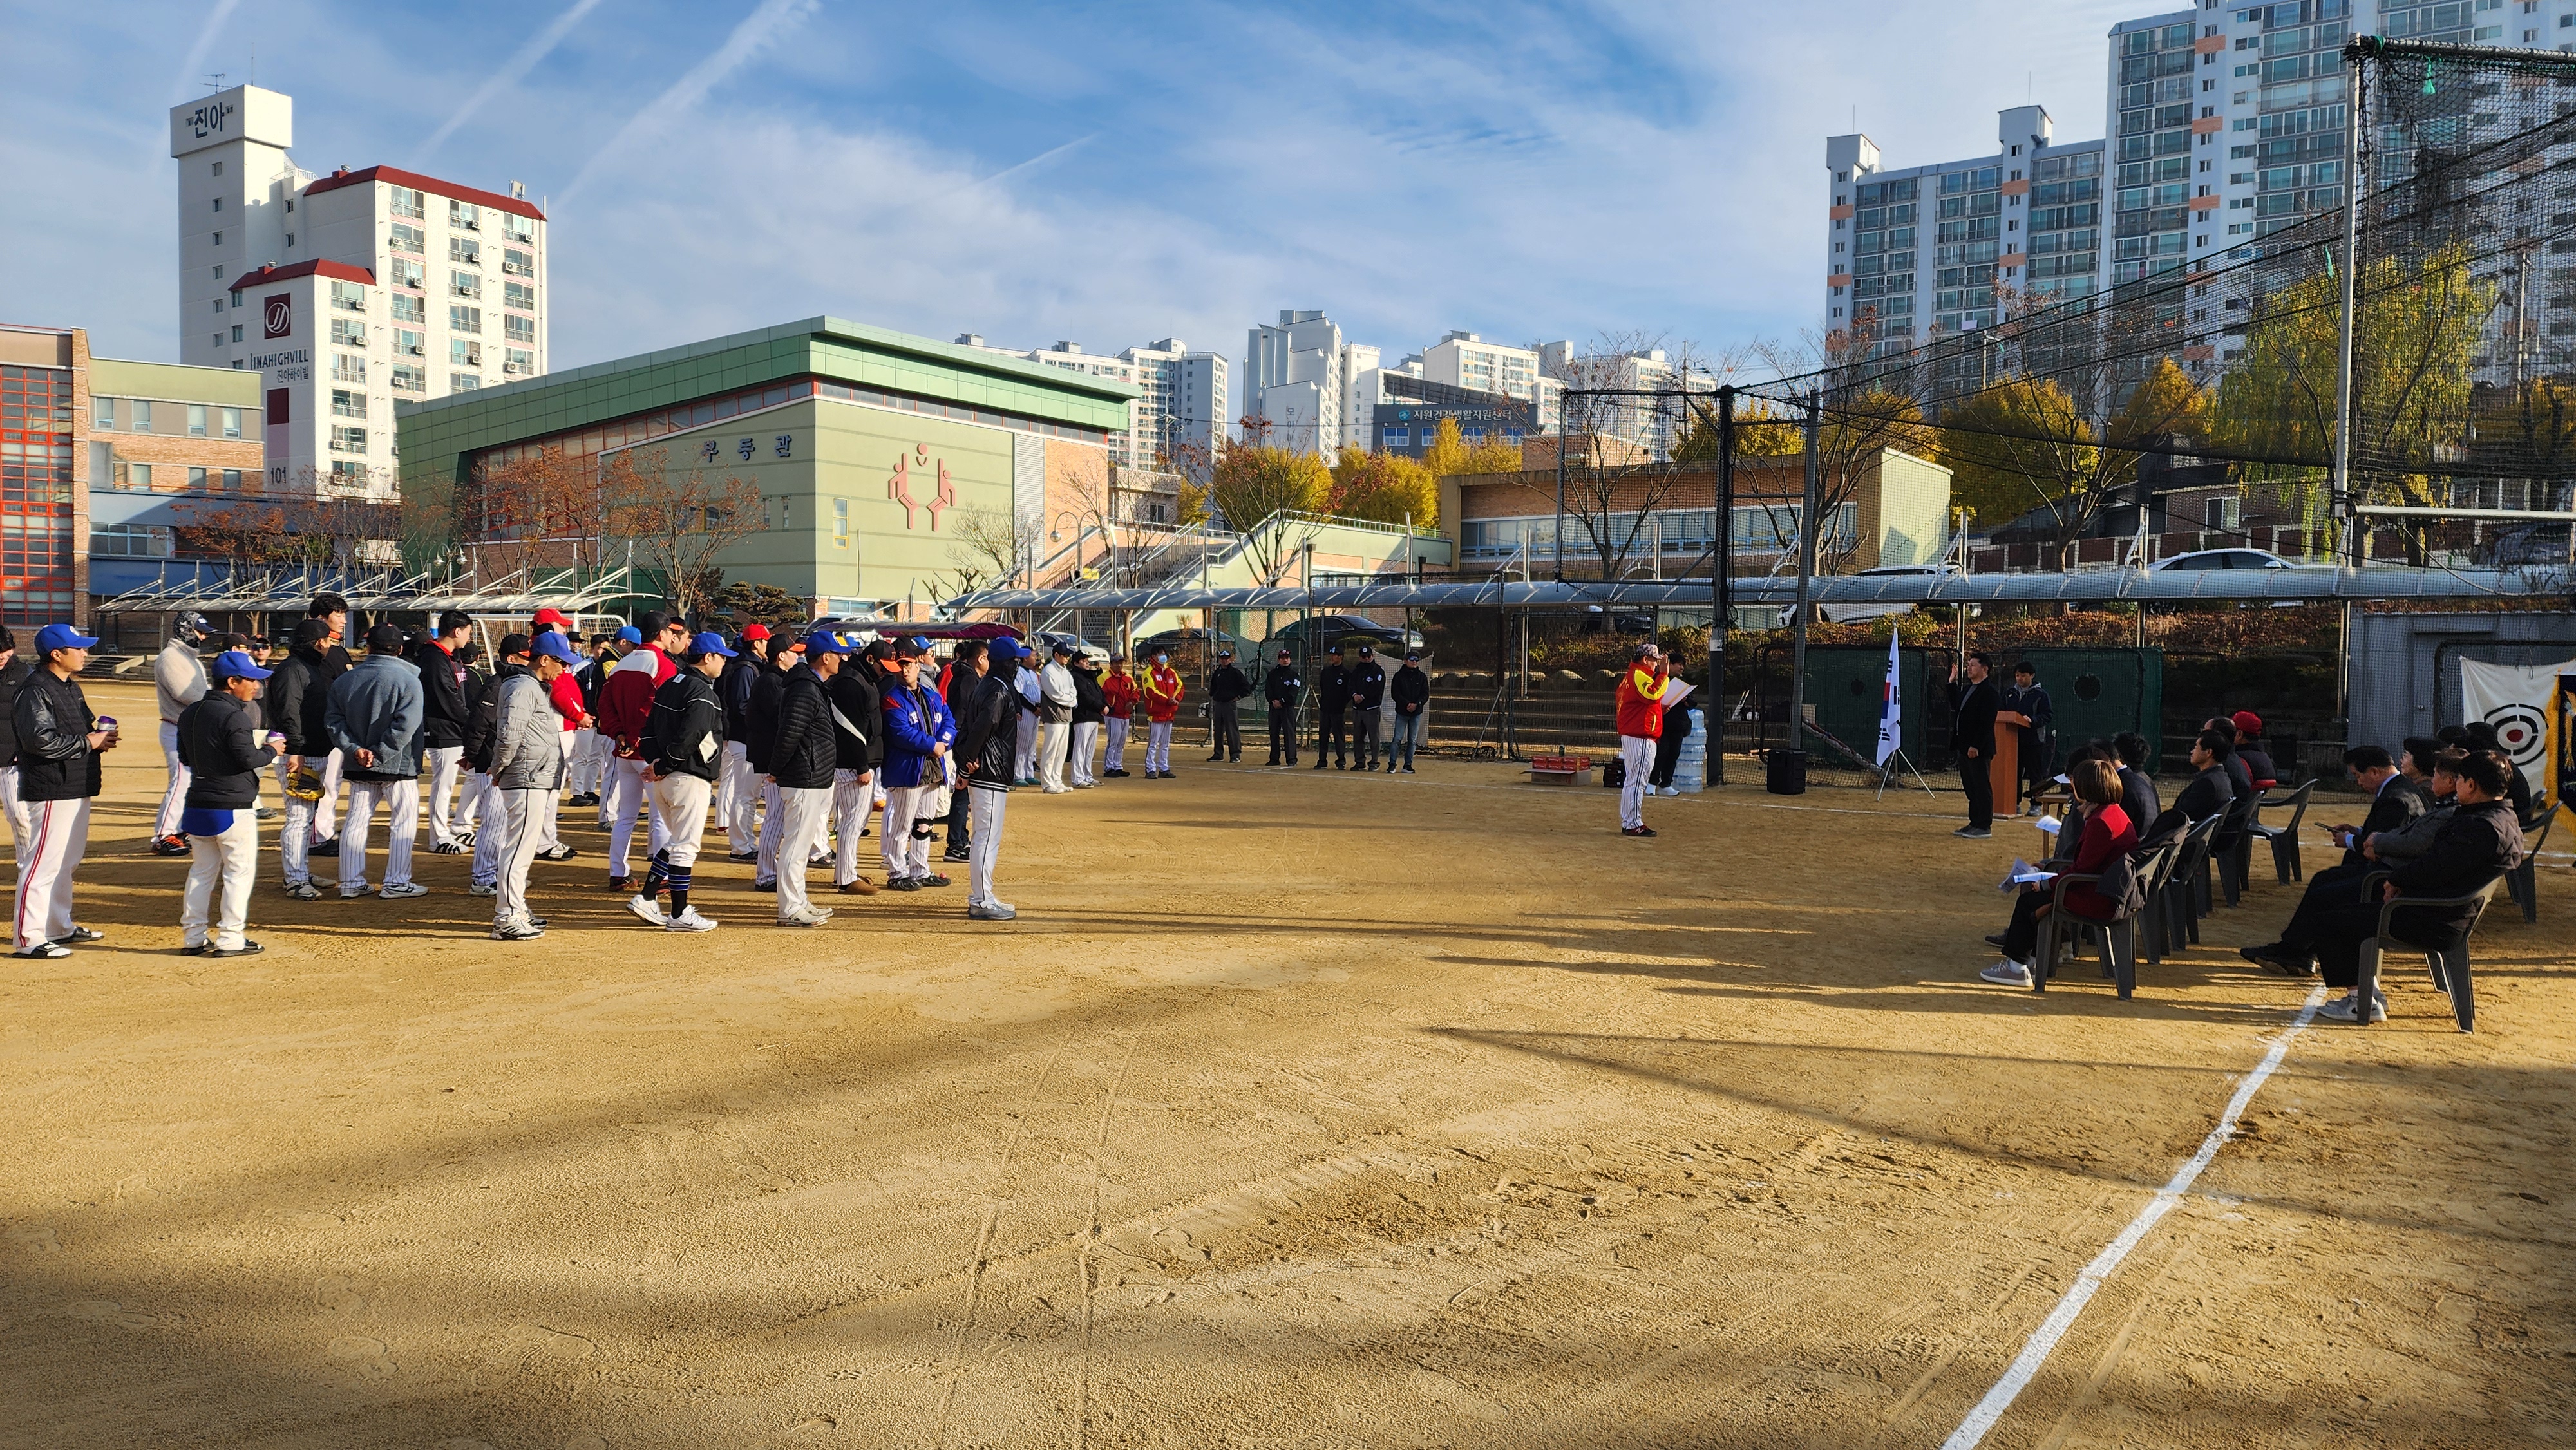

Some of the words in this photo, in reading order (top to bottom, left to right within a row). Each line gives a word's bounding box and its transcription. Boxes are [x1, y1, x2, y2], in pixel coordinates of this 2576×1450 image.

[194, 102, 225, 138] 진아
[277, 365, 308, 384] 진아하이빌
[270, 467, 287, 484] 101
